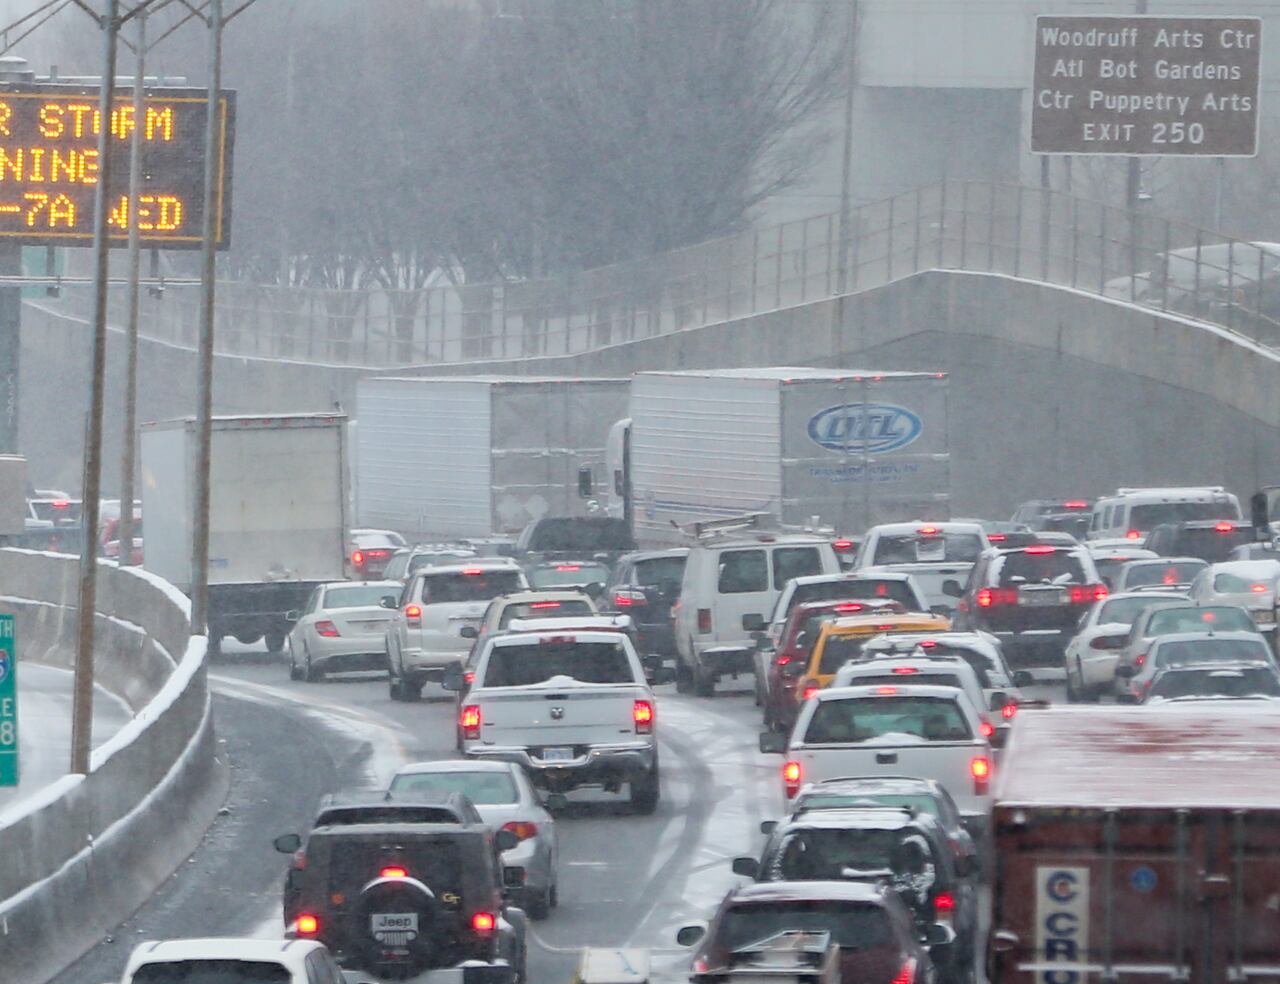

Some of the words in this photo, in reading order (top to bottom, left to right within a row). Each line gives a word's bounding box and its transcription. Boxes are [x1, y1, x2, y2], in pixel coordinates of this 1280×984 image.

[1042, 27, 1139, 47] Woodruff
[1153, 29, 1204, 48] Arts
[1220, 29, 1255, 49] Ctr
[1051, 58, 1084, 78] Atl
[1099, 59, 1138, 79] Bot
[1154, 60, 1241, 80] Gardens
[1040, 89, 1074, 109] Ctr
[1090, 90, 1190, 116] Puppetry
[1202, 92, 1252, 112] Arts
[1083, 123, 1135, 141] EXIT
[1151, 122, 1205, 145] 250
[378, 915, 412, 929] Jeep
